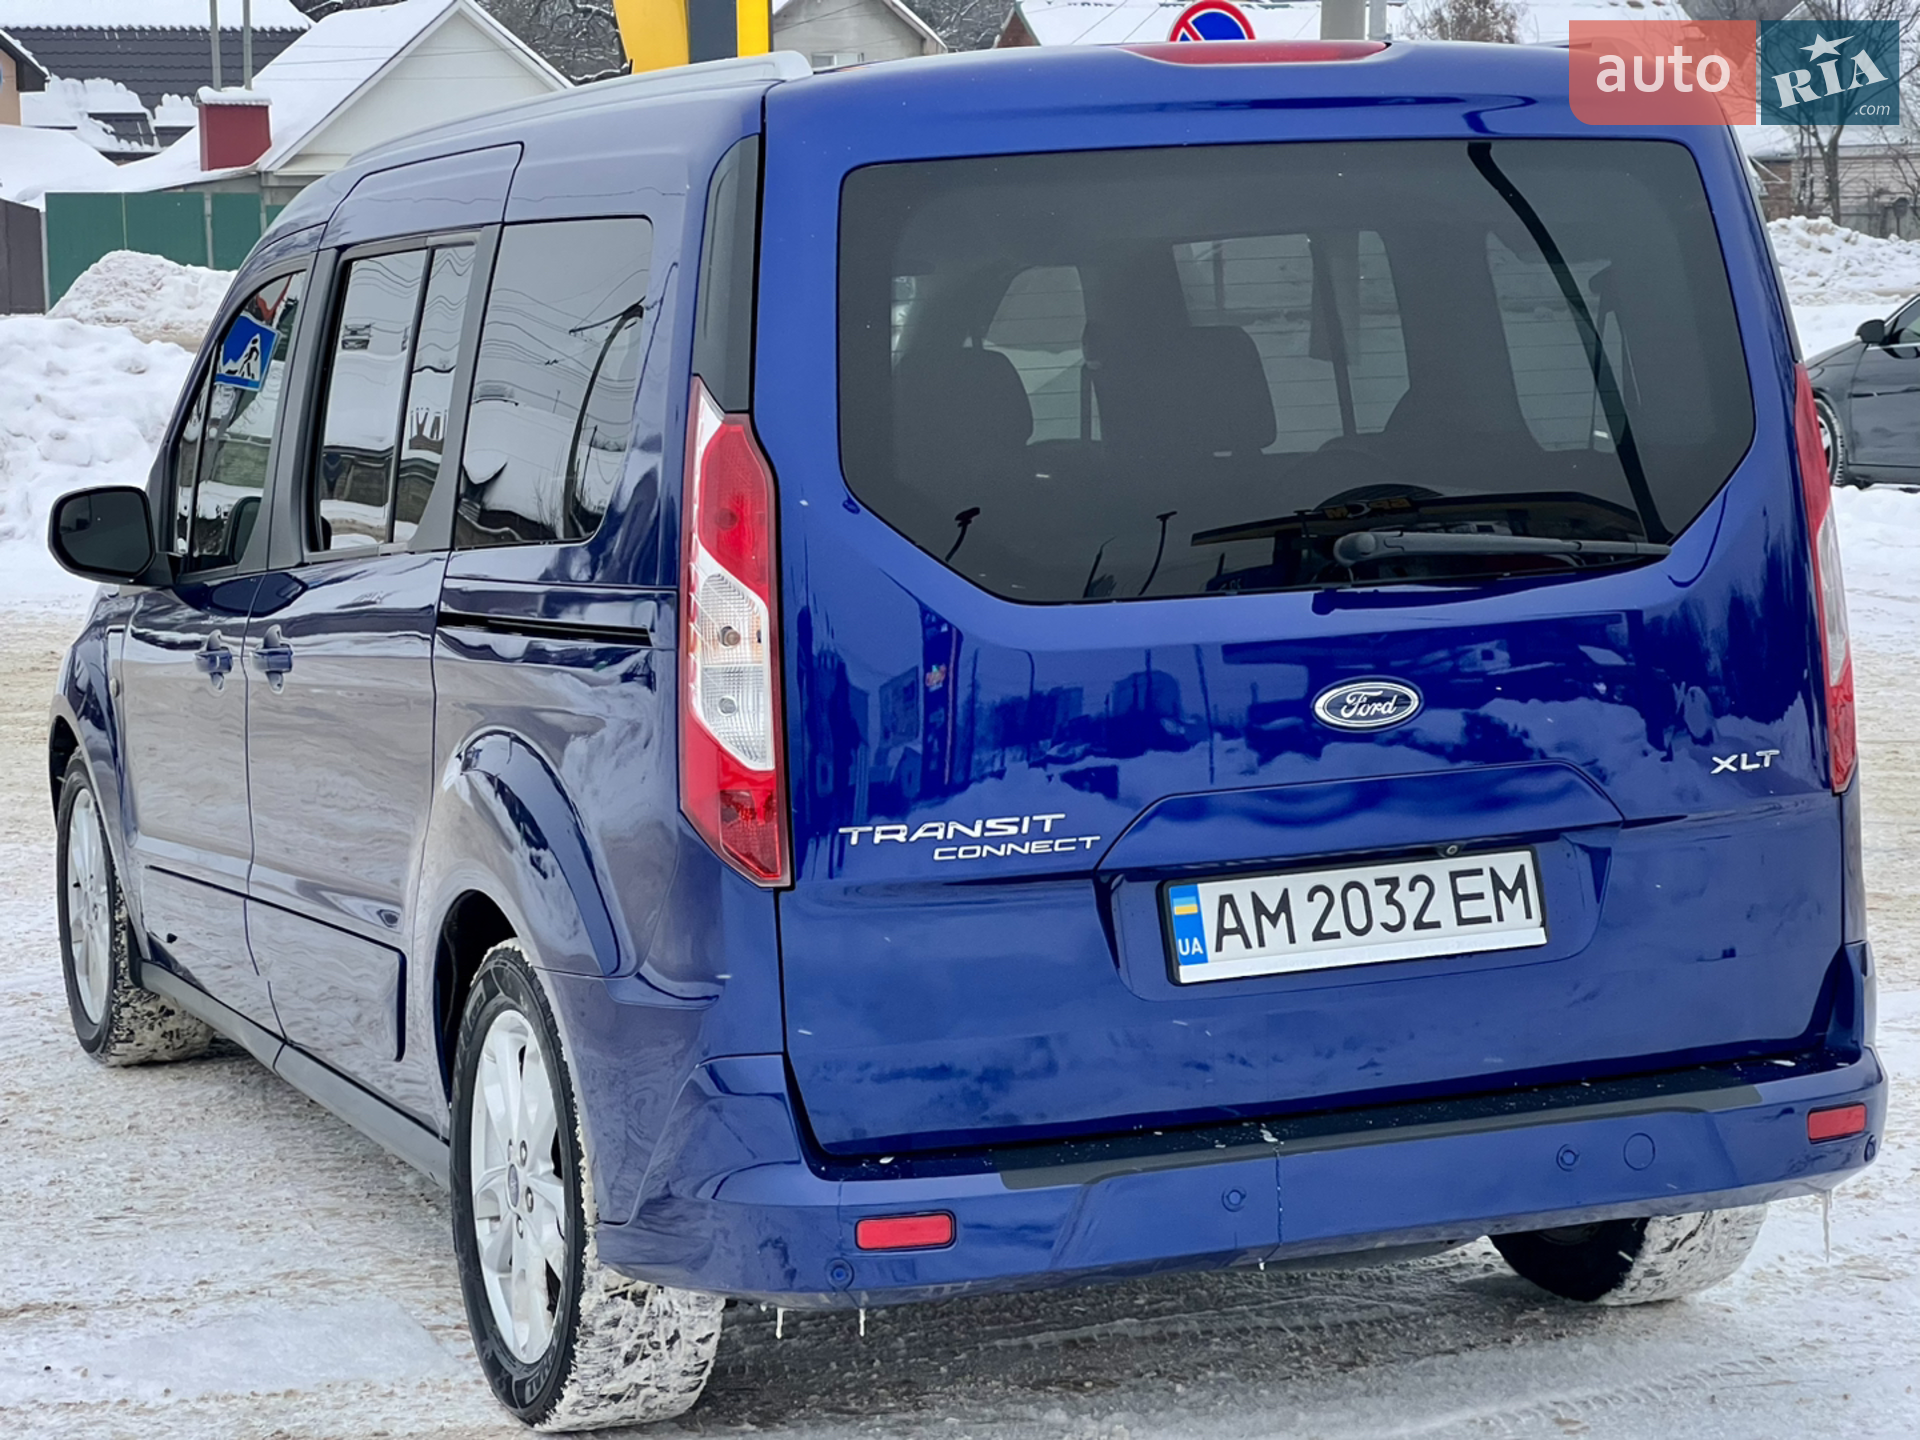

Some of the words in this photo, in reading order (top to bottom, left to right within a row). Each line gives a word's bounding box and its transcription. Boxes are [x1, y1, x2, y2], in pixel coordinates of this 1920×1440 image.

[1340, 690, 1398, 718] Ford
[1710, 749, 1781, 775] XLT
[838, 813, 1066, 845] TRANSIT
[933, 836, 1101, 861] CONNECT
[1214, 887, 1297, 953] AM
[1306, 874, 1442, 942] 2032
[1448, 863, 1534, 927] EM
[1178, 937, 1204, 957] UA
